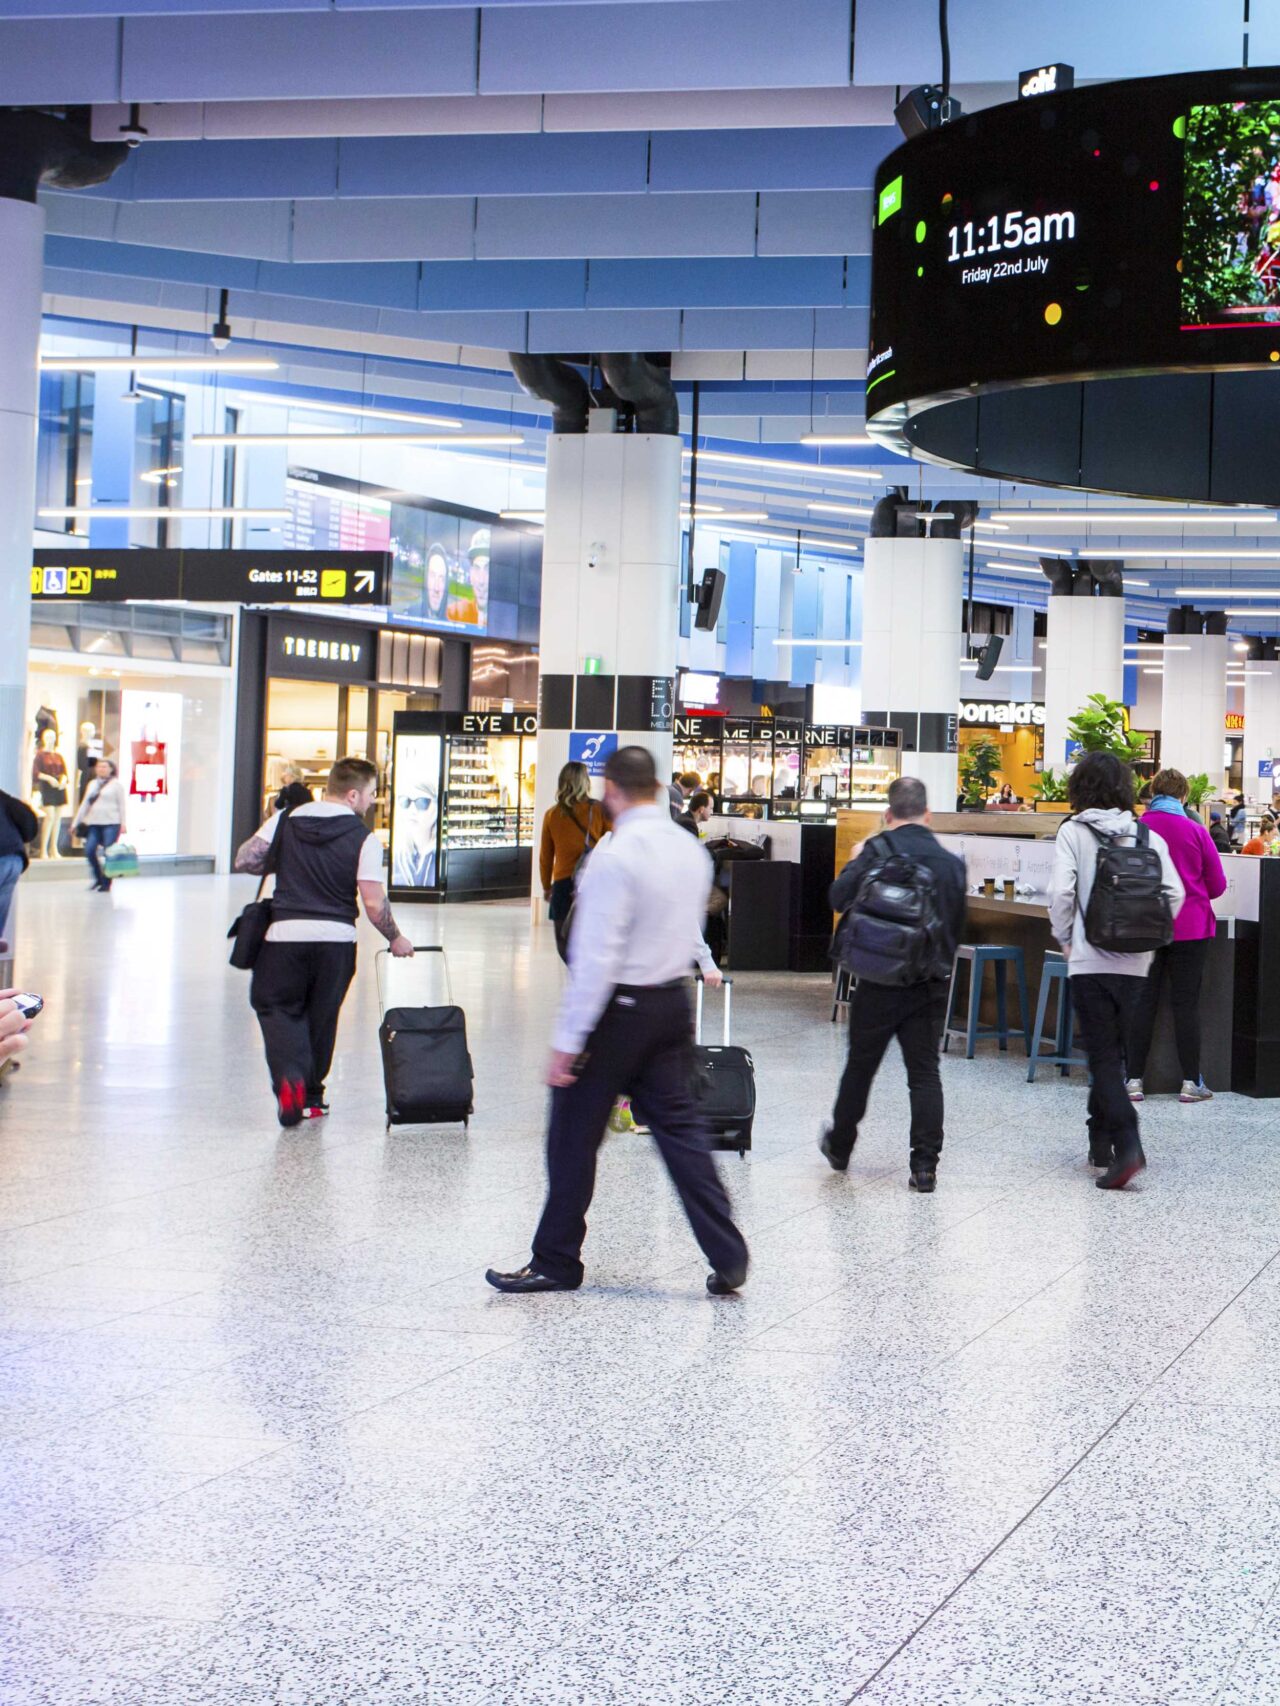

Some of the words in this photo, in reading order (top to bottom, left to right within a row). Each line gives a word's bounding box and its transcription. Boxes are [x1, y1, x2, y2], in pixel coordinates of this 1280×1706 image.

[947, 210, 1076, 262] 11:15am
[961, 266, 993, 285] Friday
[993, 258, 1023, 278] 22nd
[1024, 255, 1049, 274] July
[249, 569, 283, 583] Gates
[285, 569, 318, 584] 11-52
[284, 636, 361, 662] TRENERY
[463, 715, 502, 732] EYE
